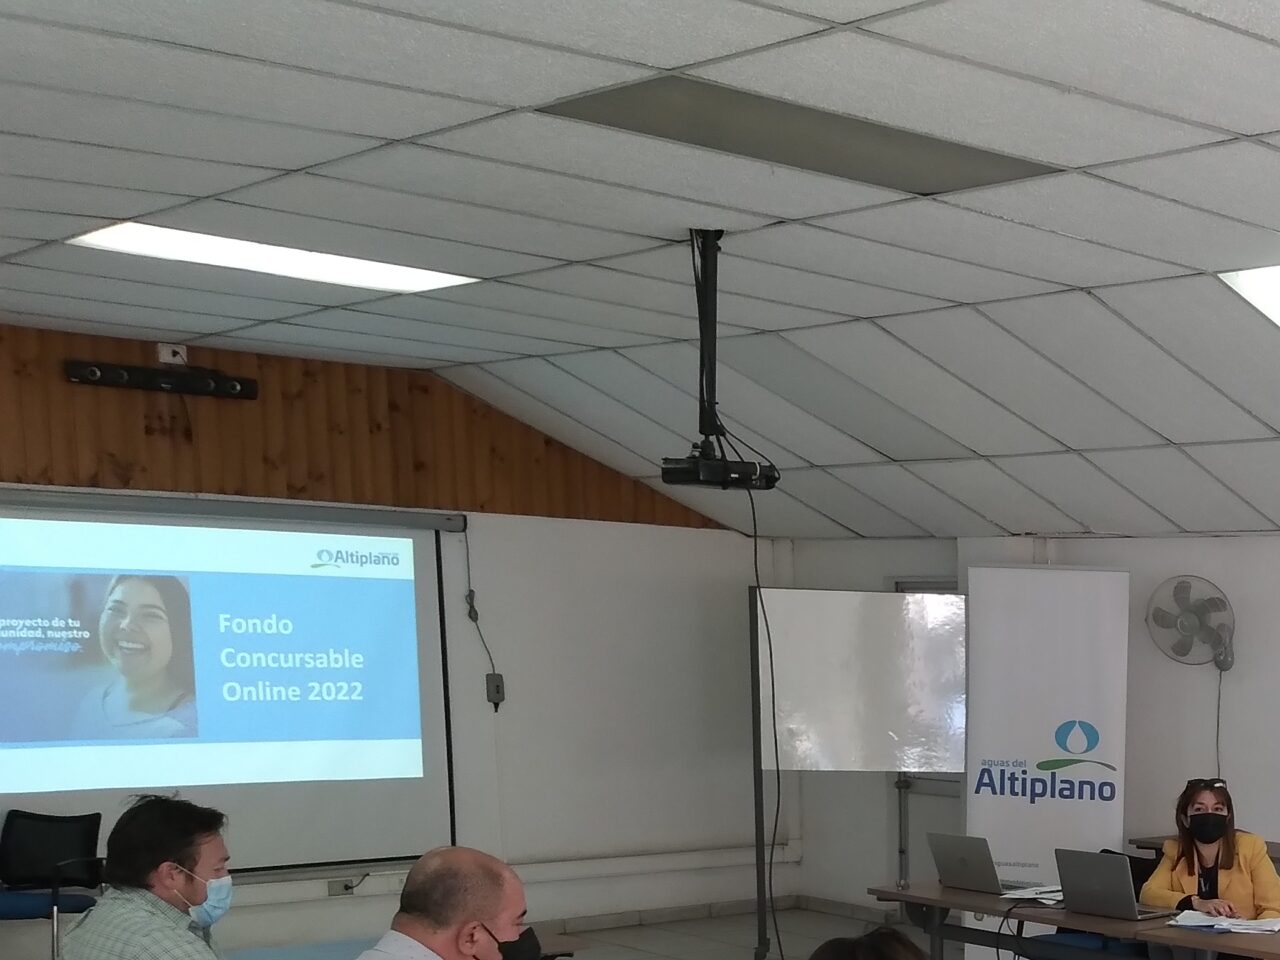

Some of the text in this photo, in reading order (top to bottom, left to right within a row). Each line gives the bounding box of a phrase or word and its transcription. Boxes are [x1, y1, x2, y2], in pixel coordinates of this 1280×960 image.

[334, 549, 400, 567] Altiplano
[51, 617, 66, 627] de
[68, 618, 81, 627] tu
[218, 613, 294, 634] Fondo
[47, 629, 90, 639] nuestro
[220, 647, 364, 668] Concursable
[222, 681, 363, 701] Online 2022
[981, 758, 1027, 768] aguas del
[974, 767, 1117, 805] Altiplano
